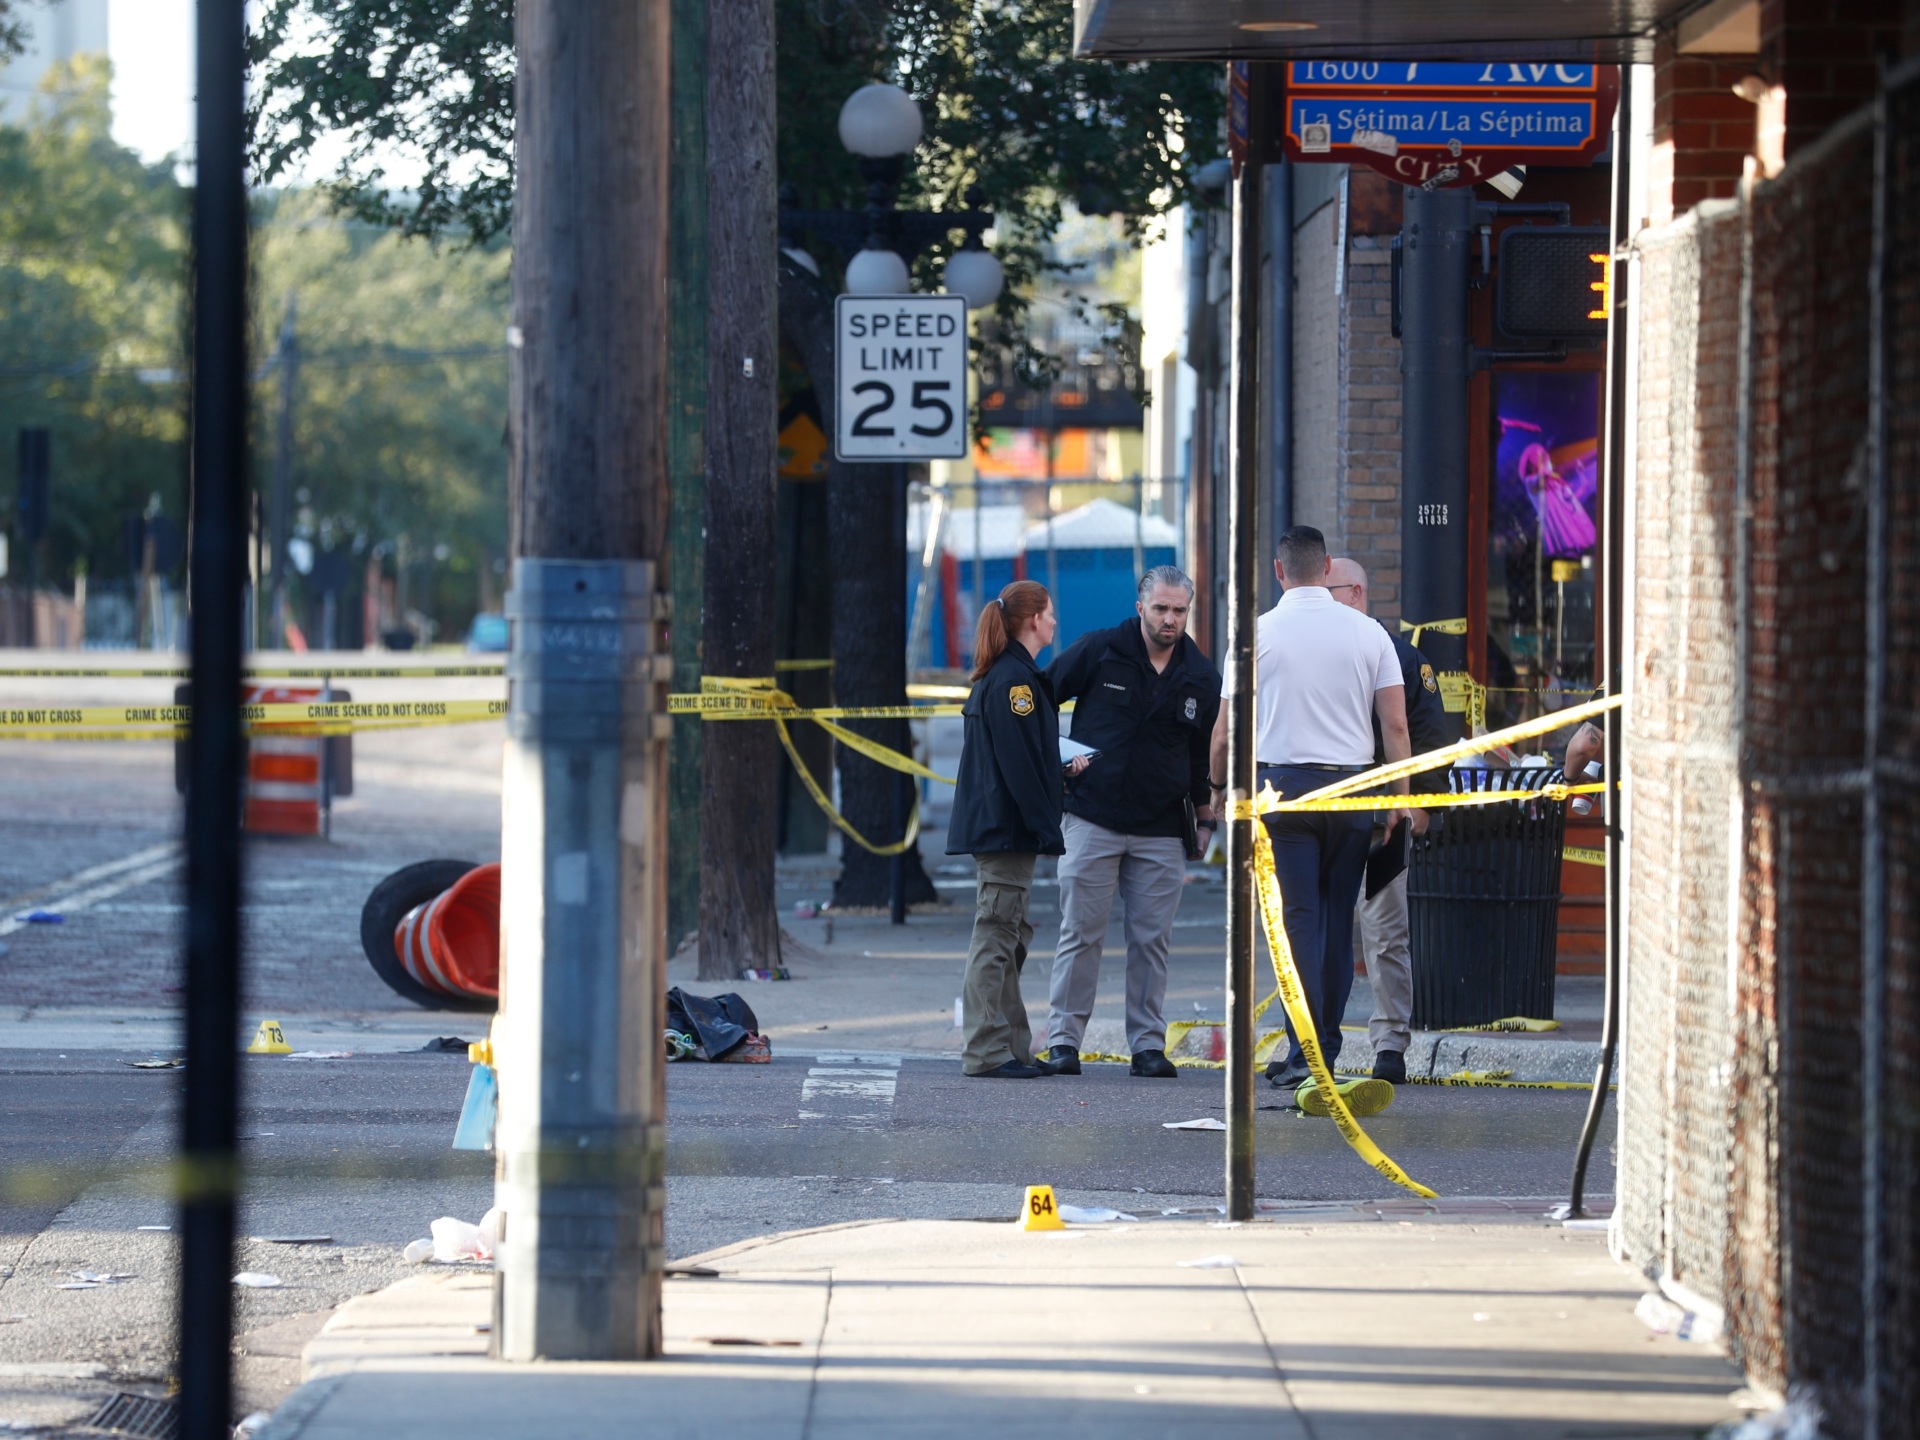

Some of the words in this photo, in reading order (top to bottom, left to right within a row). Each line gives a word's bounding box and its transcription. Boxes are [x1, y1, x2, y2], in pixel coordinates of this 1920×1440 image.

[1480, 110, 1583, 138] Séptima
[850, 314, 955, 337] SPEED
[861, 347, 943, 370] LIMIT
[851, 380, 954, 437] 25
[308, 705, 339, 718] CRIME
[343, 704, 373, 717] SCENE
[377, 704, 389, 716] DO
[393, 704, 411, 716] NOT
[414, 703, 446, 716] CROSS
[488, 701, 510, 714] CRI
[668, 697, 697, 709] CRIME
[701, 697, 731, 709] SCENE
[11, 711, 24, 723] DO
[28, 711, 46, 723] NOT
[50, 710, 82, 723] CROSS
[125, 708, 157, 722] CRIME
[161, 708, 191, 721] SCENE
[241, 706, 265, 719] ROSS
[268, 1027, 284, 1043] 73
[1405, 1073, 1445, 1086] SCENE
[1031, 1194, 1052, 1216] 64
